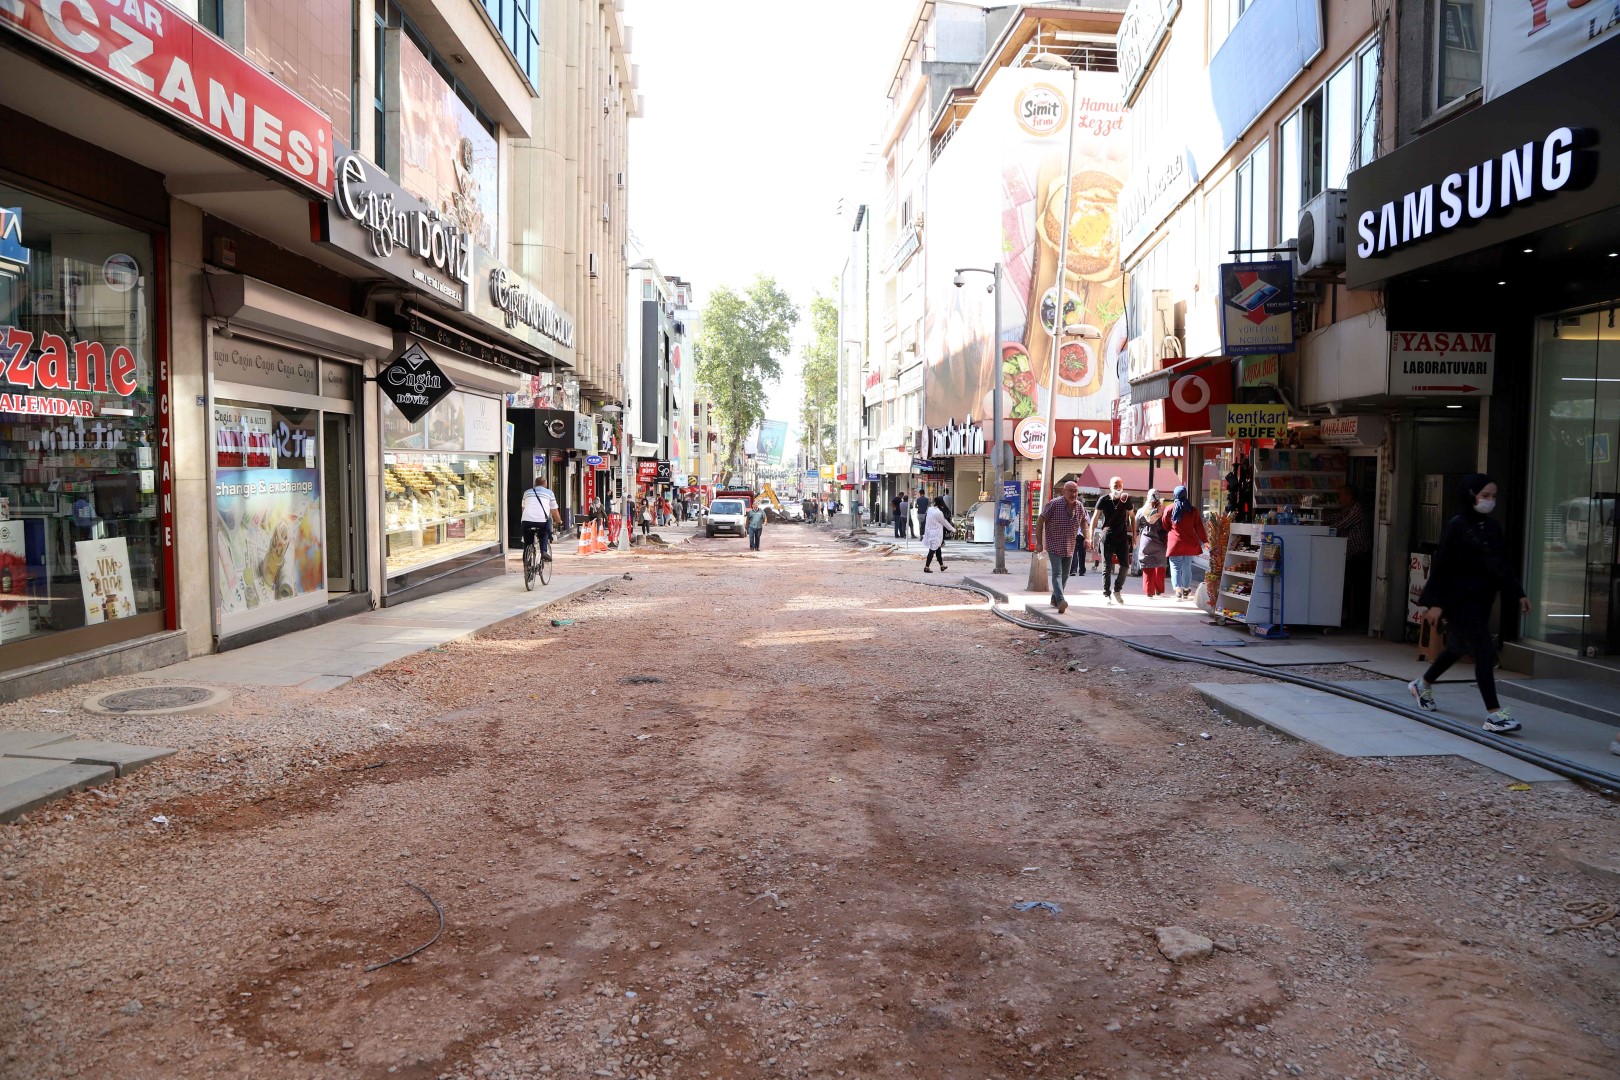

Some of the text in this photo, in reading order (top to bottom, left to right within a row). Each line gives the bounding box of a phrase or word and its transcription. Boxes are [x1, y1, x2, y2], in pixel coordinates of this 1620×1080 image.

[1024, 100, 1059, 118] Simit
[1078, 114, 1124, 136] Lezzet
[1357, 126, 1573, 259] SAMSUNG
[1400, 333, 1493, 357] YAŞAM
[213, 348, 229, 366] ngin
[1403, 361, 1487, 375] LABORATUVARI
[0, 394, 94, 418] ALEMDAR
[396, 392, 429, 405] DÖVİZ
[1238, 424, 1276, 438] BÜFE
[160, 361, 172, 547] ECZANE
[258, 480, 266, 493] &
[269, 480, 313, 494] exchange
